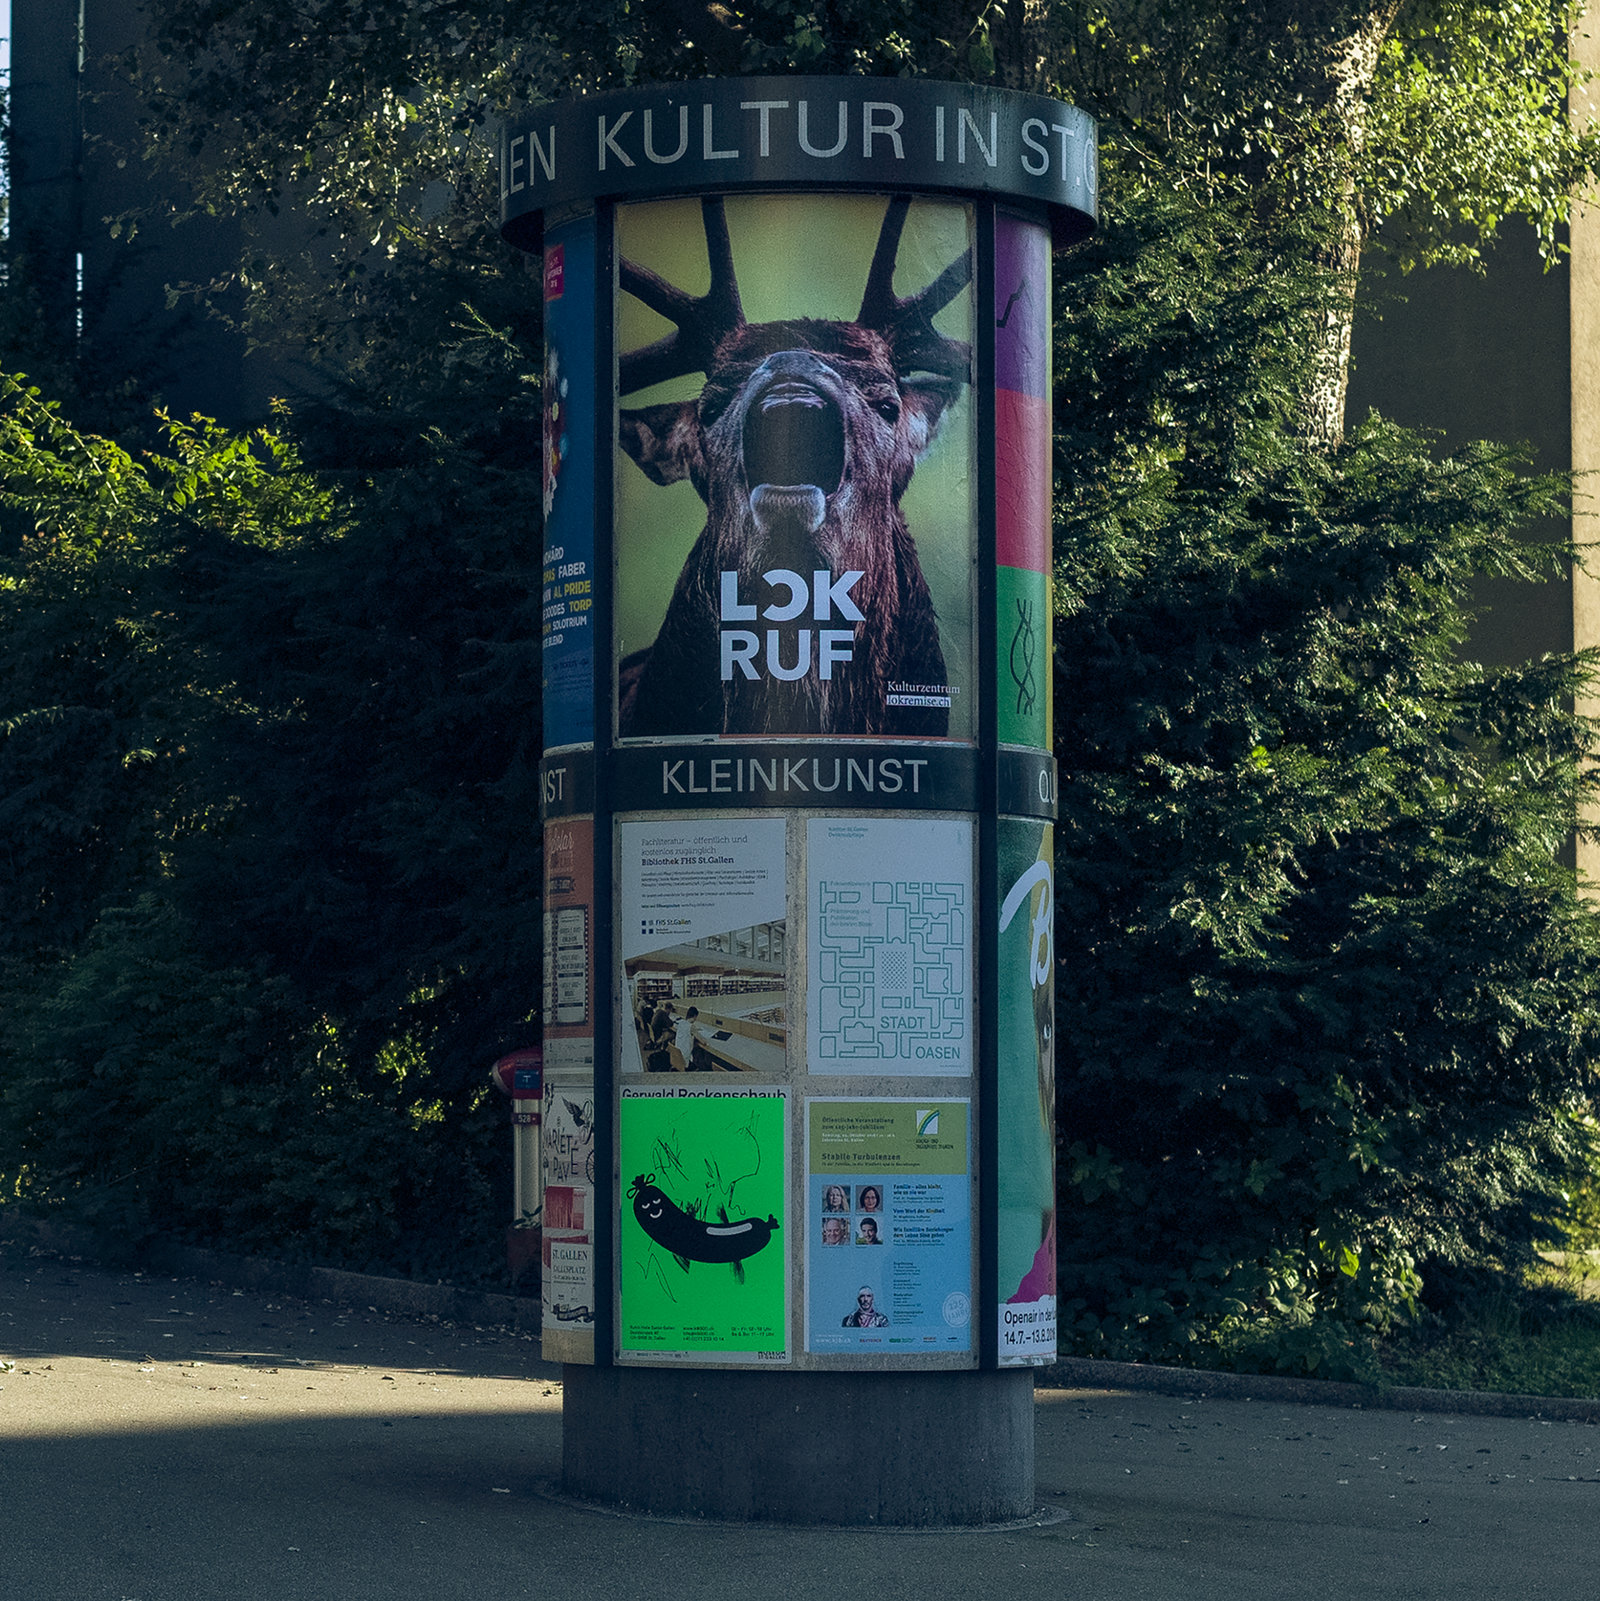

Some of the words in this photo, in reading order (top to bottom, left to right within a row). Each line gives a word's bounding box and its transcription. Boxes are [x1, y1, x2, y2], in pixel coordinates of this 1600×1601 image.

[598, 101, 904, 170] KULTUR
[936, 105, 997, 168] IN
[558, 561, 586, 579] FABER
[564, 580, 591, 596] PRIDE
[568, 598, 592, 613] TORP
[552, 615, 587, 631] SOLOTRIUM
[721, 630, 854, 681] RUF
[887, 681, 960, 694] Kulturzentrum
[887, 695, 950, 707] lokremise.ch
[663, 758, 928, 794] KLEINKUNST
[693, 836, 730, 845] öffentlich
[731, 834, 748, 844] und
[642, 858, 679, 866] Bibliothek
[680, 857, 696, 865] FHS
[880, 1016, 926, 1029] STADT
[916, 1046, 960, 1059] OASEN
[678, 1088, 786, 1098] Rockenschaub
[518, 1114, 531, 1123] 528
[560, 1249, 588, 1260] GALLEN
[1004, 1309, 1038, 1327] Openair
